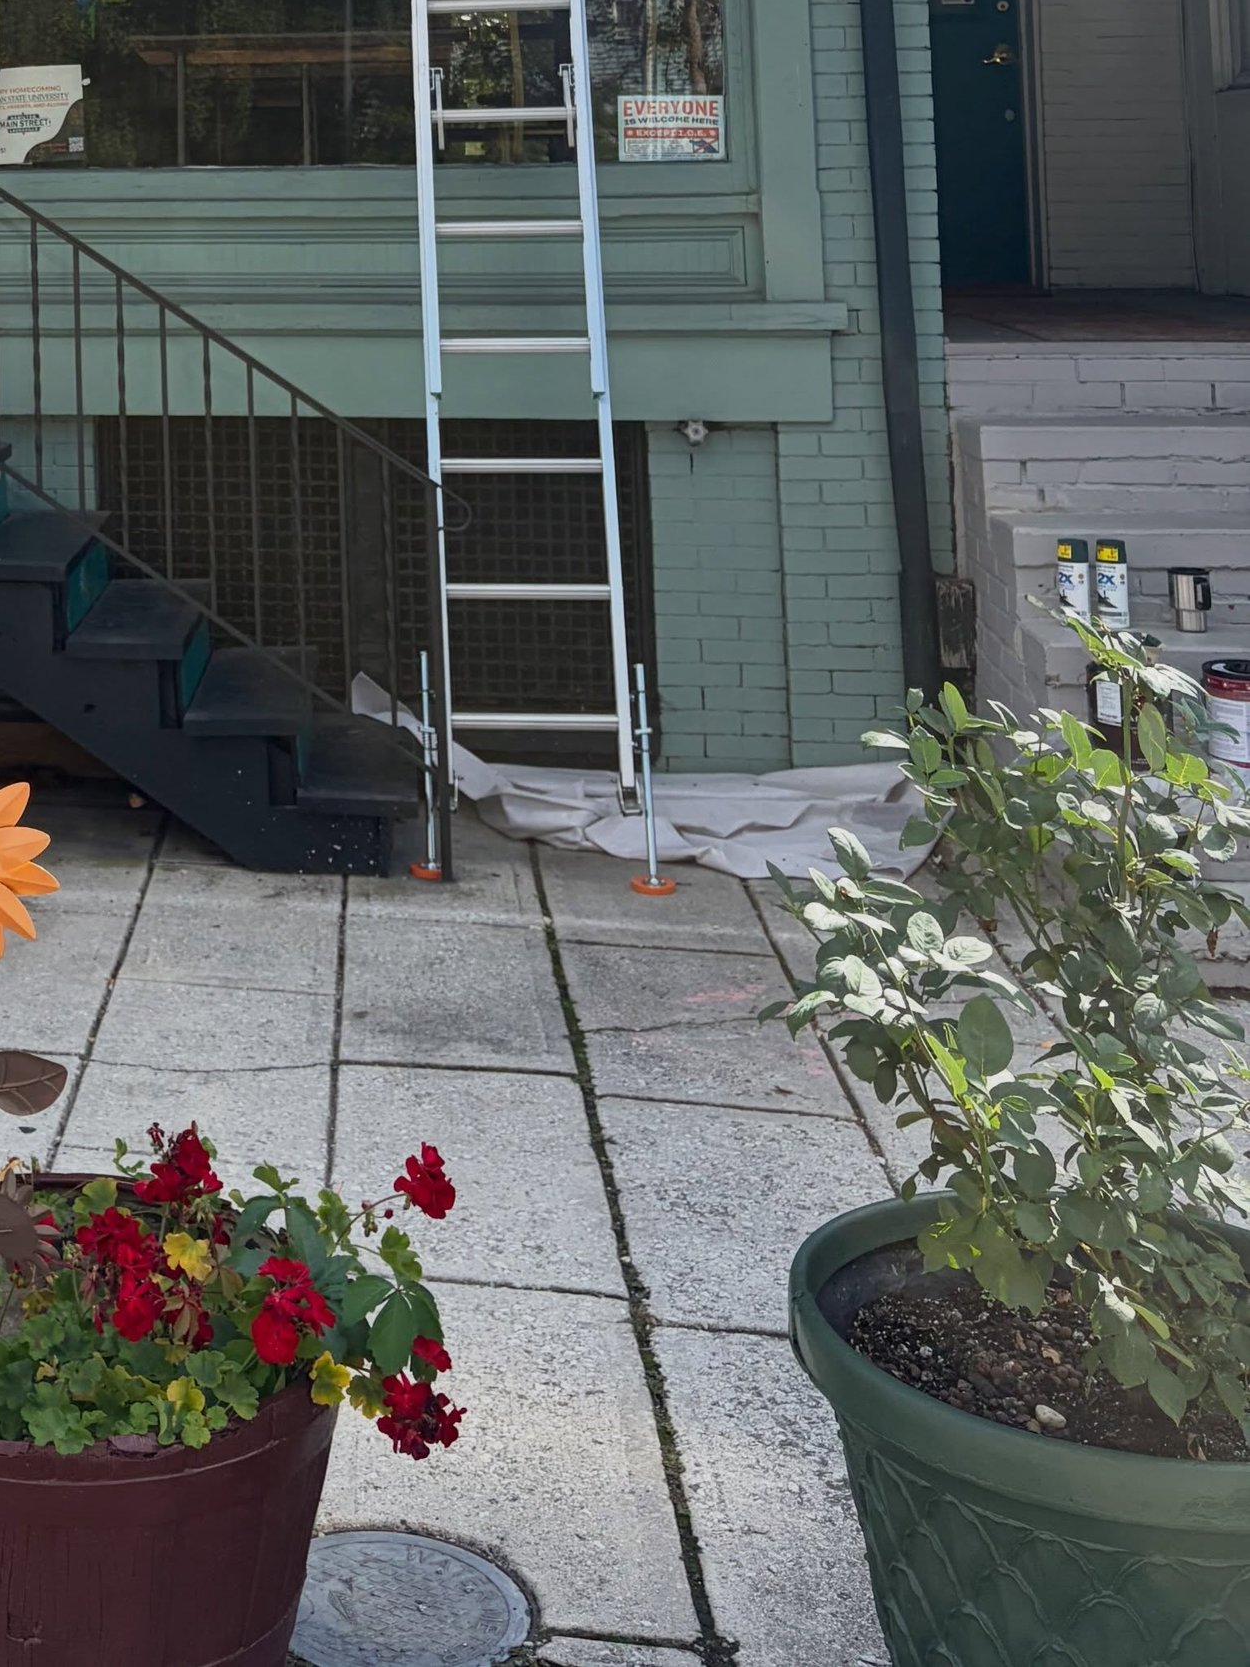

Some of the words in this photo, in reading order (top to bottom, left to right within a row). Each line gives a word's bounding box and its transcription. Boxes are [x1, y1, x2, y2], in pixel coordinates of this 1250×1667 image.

[9, 86, 61, 94] HOMECOMING
[8, 94, 27, 103] STATE
[27, 93, 69, 102] UNIVERSITY
[623, 100, 719, 117] EVERYONE
[0, 120, 19, 128] MAIN
[19, 118, 48, 127] STREET
[638, 116, 690, 124] WELCOME
[691, 117, 719, 126] HERE
[636, 129, 676, 137] EXCEPT
[1058, 572, 1074, 584] 2X
[1097, 572, 1116, 585] 2X
